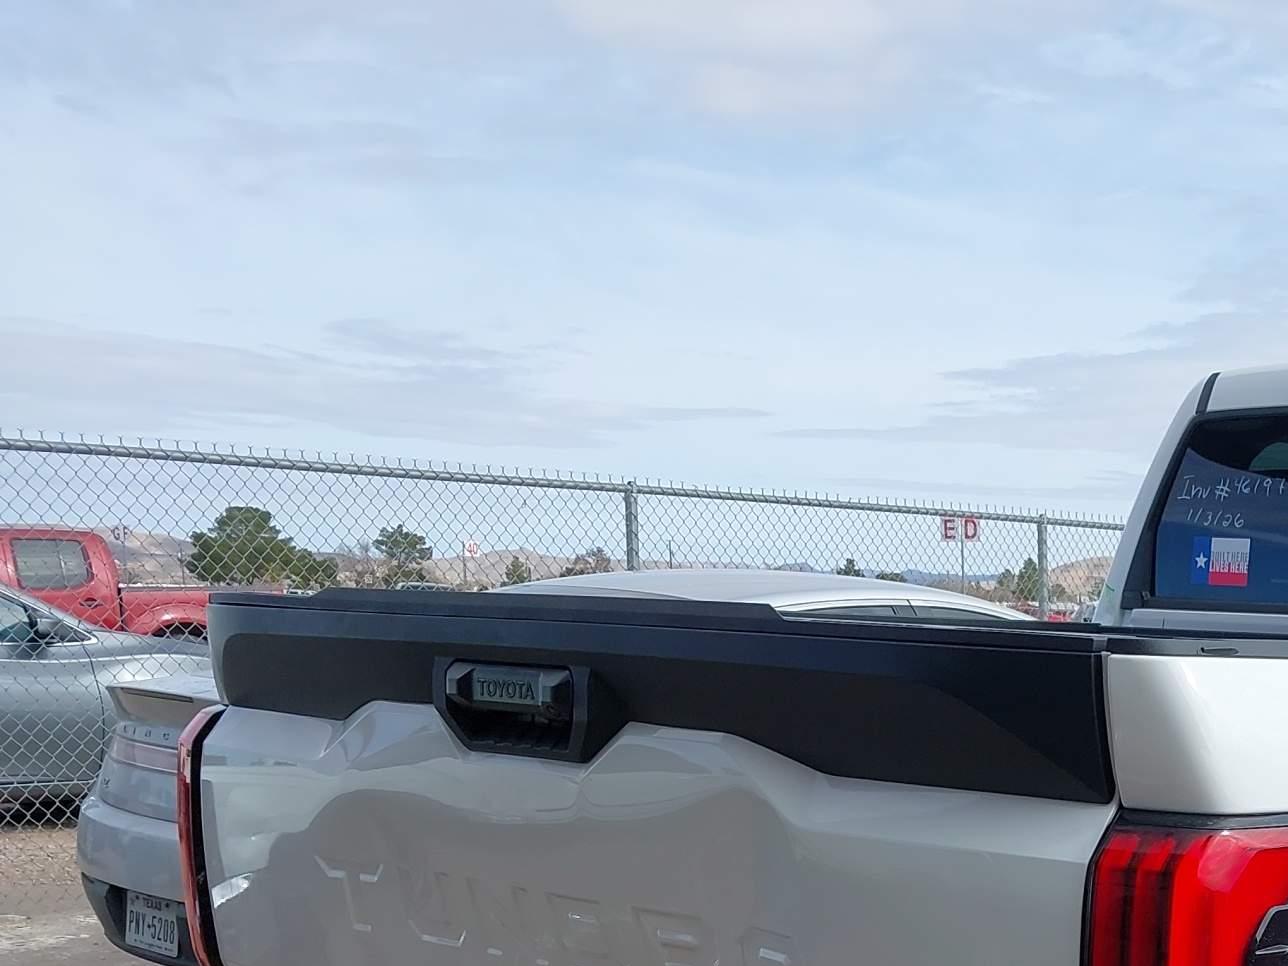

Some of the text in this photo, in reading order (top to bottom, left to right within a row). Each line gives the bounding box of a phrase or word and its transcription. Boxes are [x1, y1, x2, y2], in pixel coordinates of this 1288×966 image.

[1177, 475, 1211, 500] Inv
[1186, 507, 1245, 528] 1/3/26
[1209, 560, 1249, 574] LIVES HERE
[477, 677, 536, 701] TOYOTA
[142, 896, 163, 912] TEXAS
